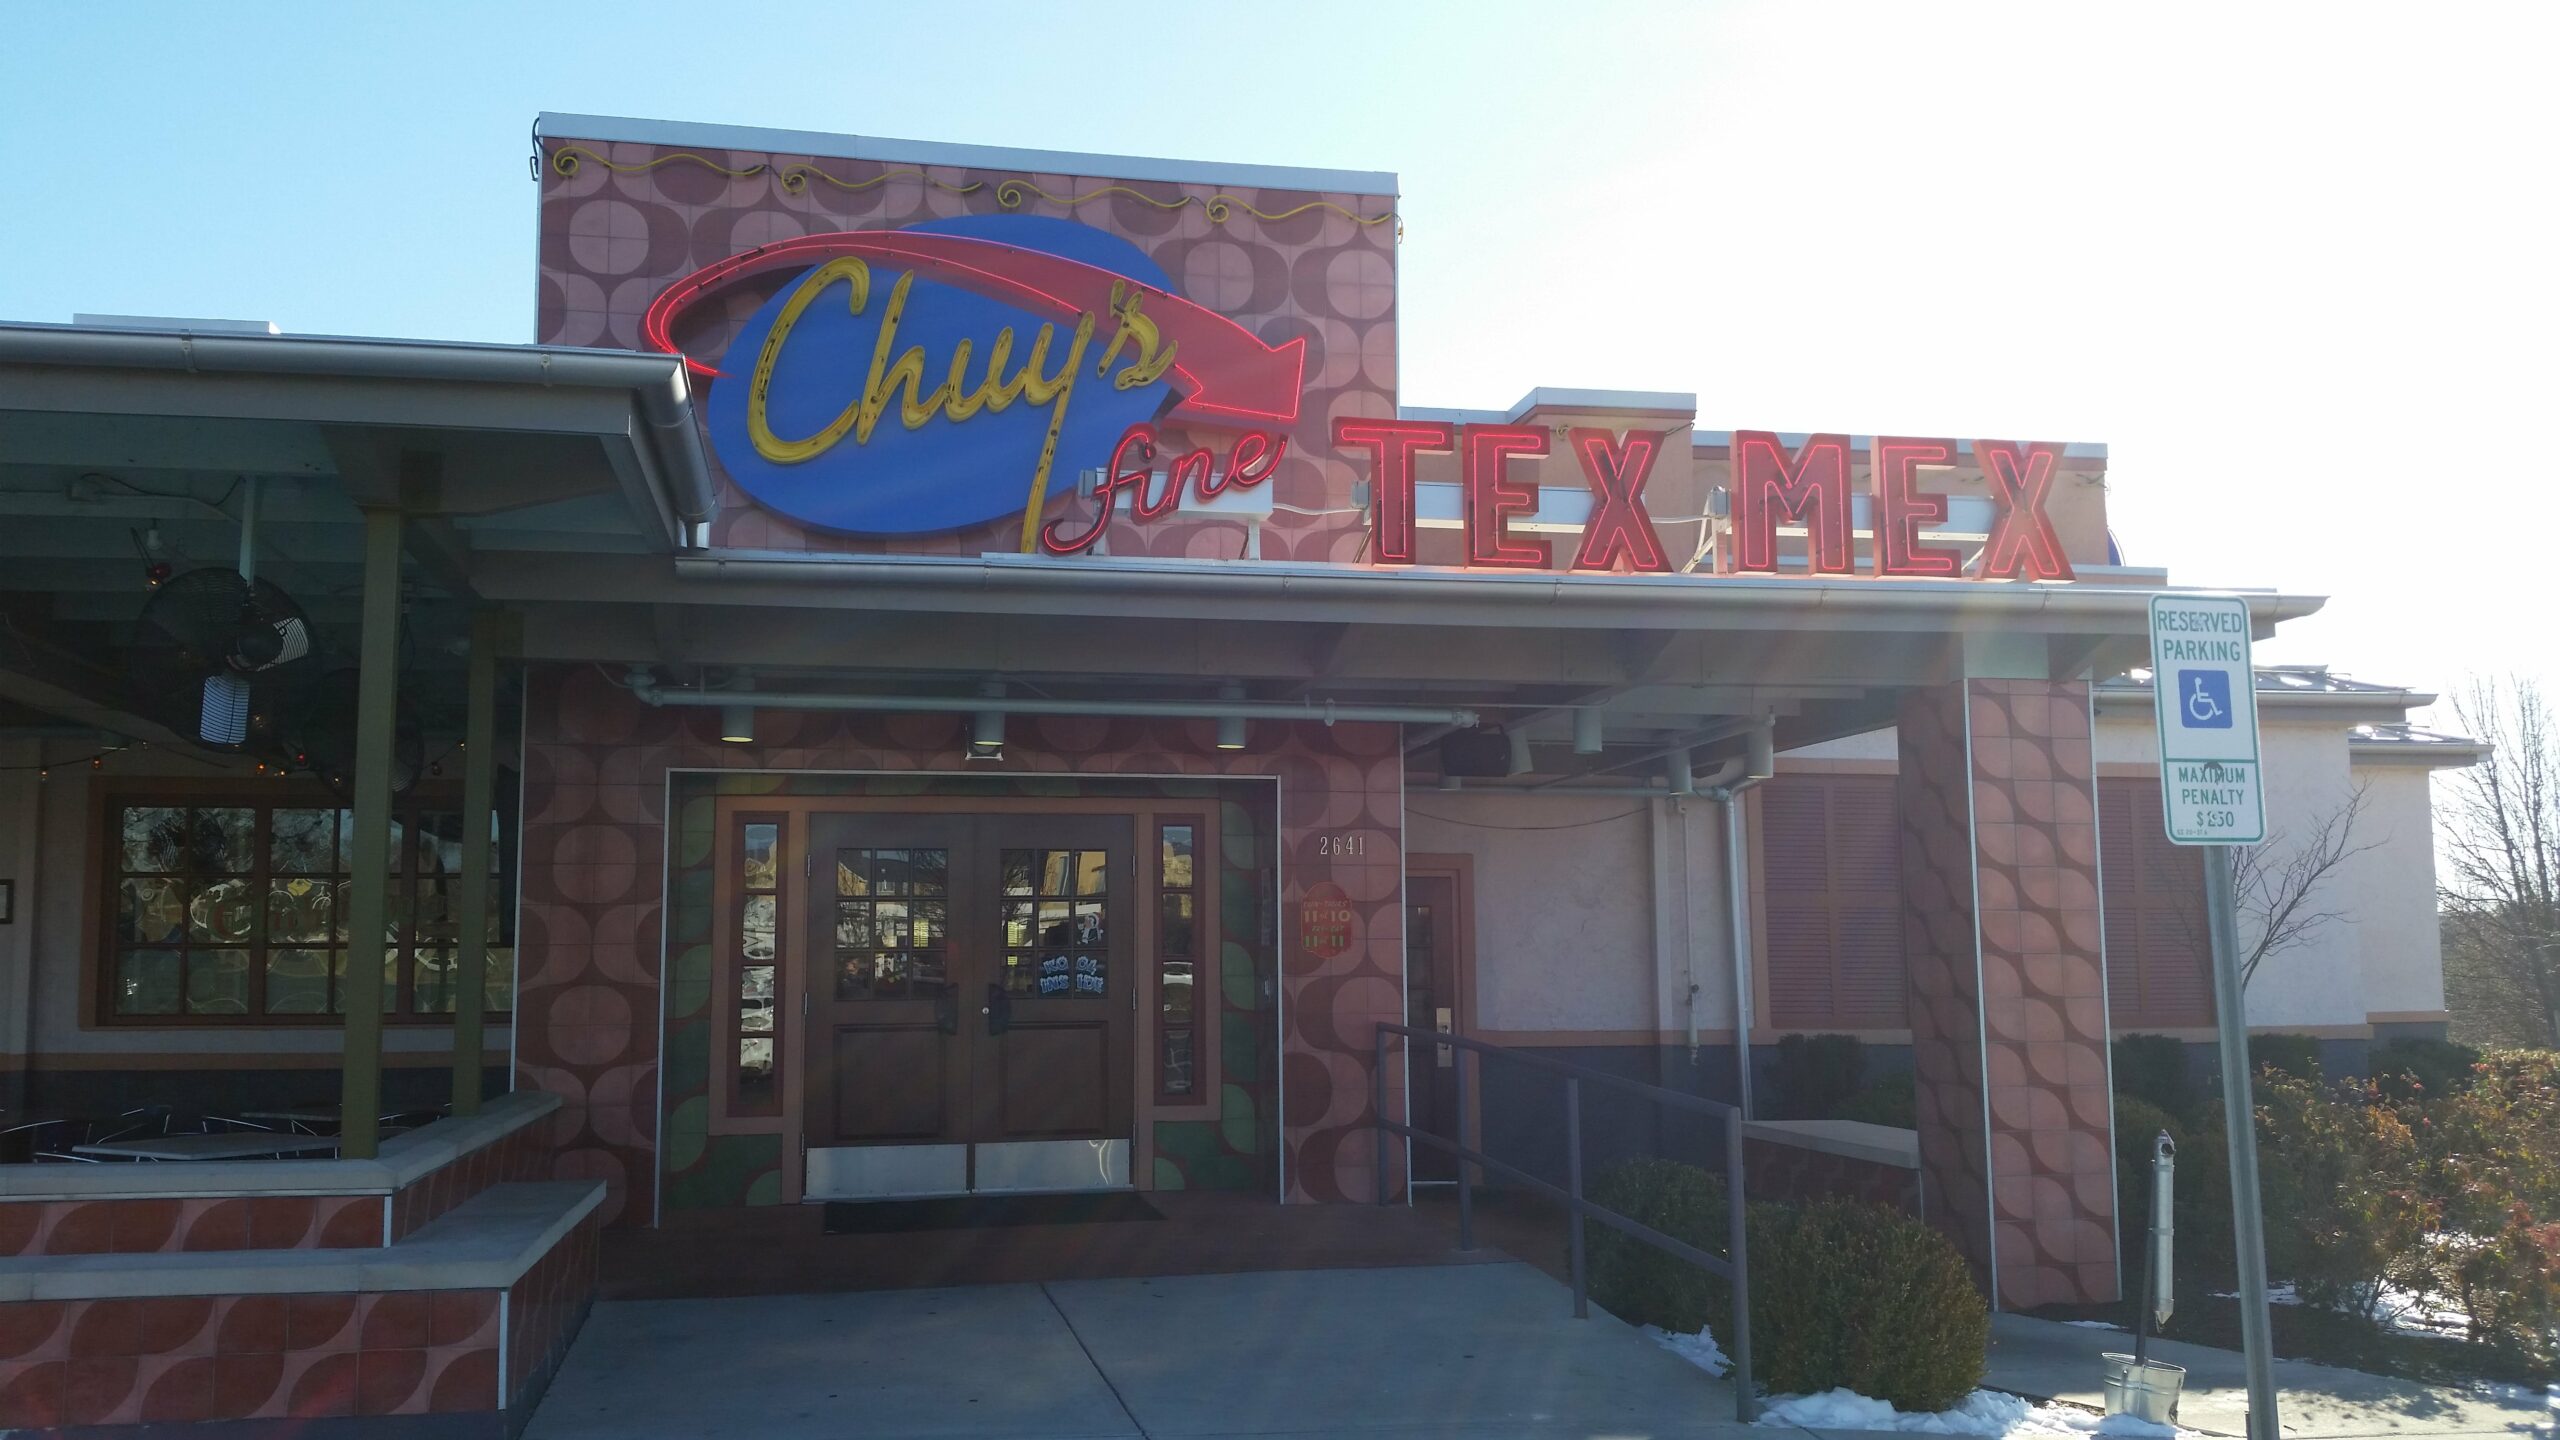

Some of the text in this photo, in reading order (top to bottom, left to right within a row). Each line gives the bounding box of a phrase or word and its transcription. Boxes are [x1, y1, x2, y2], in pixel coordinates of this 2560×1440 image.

[747, 256, 1178, 554] Chuy's
[1041, 422, 1288, 555] fine
[1332, 417, 2077, 582] TEX MEX
[2157, 611, 2242, 633] RESERVED
[2163, 639, 2241, 662] PARKING
[2178, 767, 2246, 784] MAXIMUM
[2182, 789, 2244, 806] PENALTY
[1320, 836, 1364, 855] 2641
